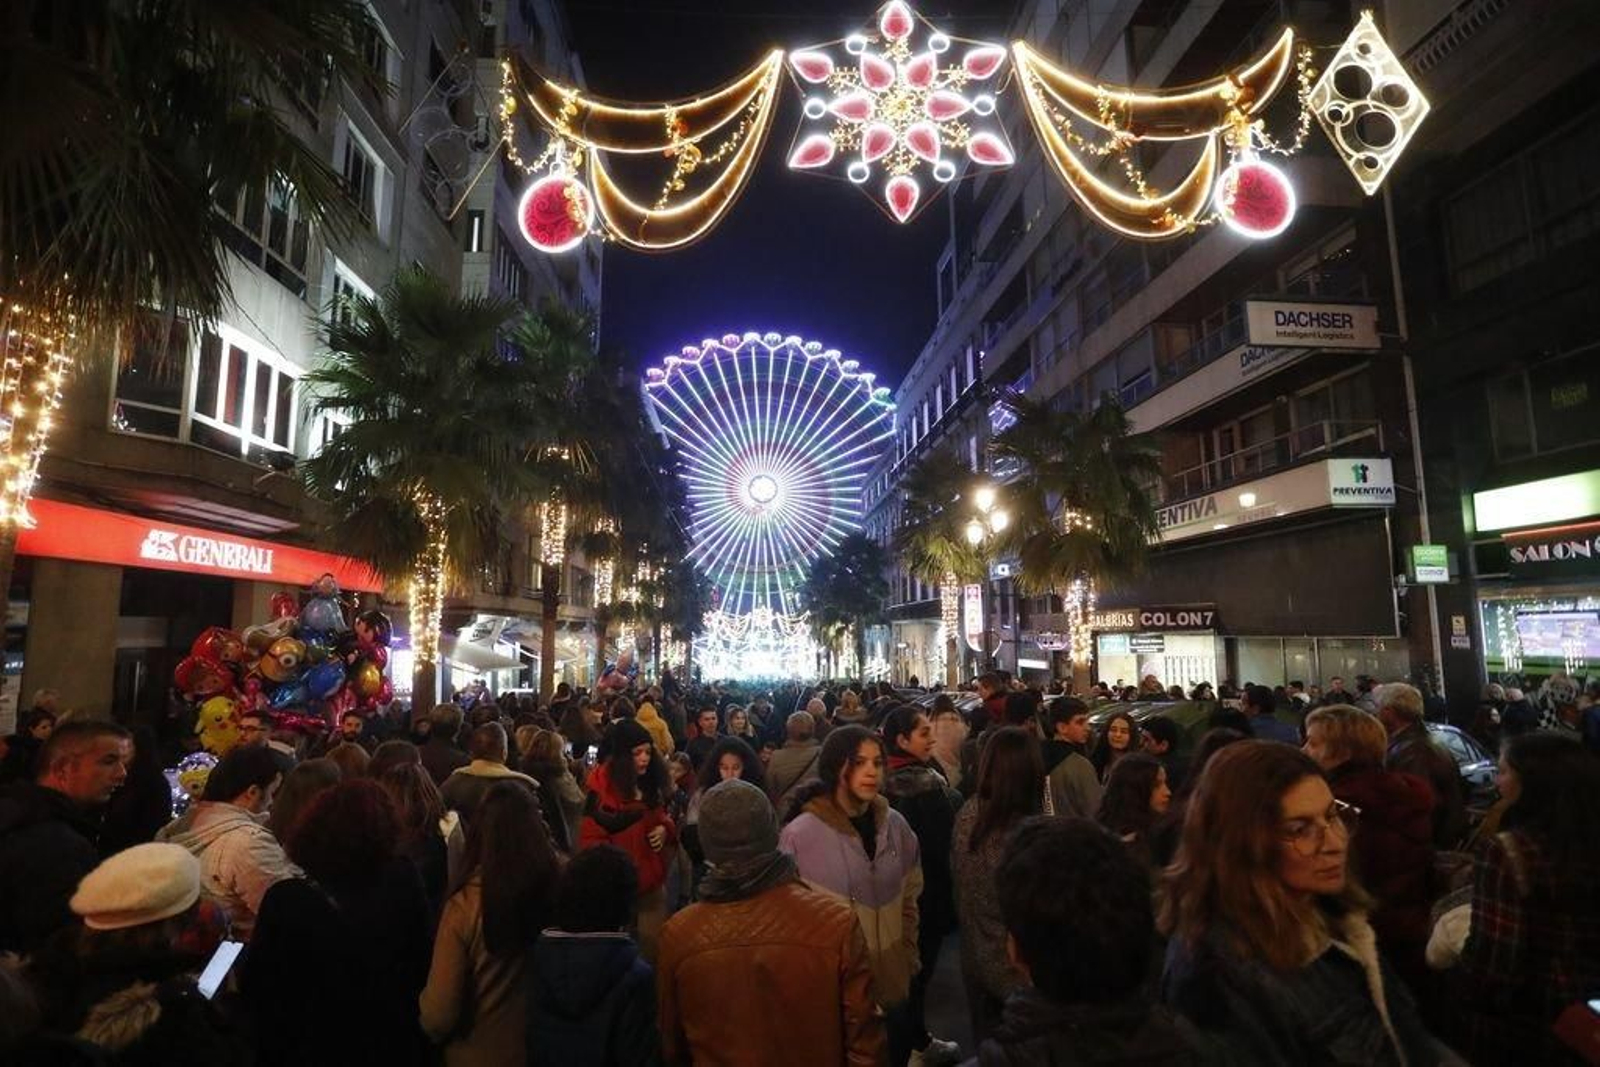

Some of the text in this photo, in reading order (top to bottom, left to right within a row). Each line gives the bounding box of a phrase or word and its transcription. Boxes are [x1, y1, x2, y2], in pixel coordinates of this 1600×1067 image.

[1274, 310, 1354, 329] DACHSER
[1276, 330, 1355, 341] Intelligent Logistics
[1333, 486, 1393, 495] PREVENTIVA
[1156, 495, 1218, 528] ENTIVA
[178, 535, 274, 574] GENERALI
